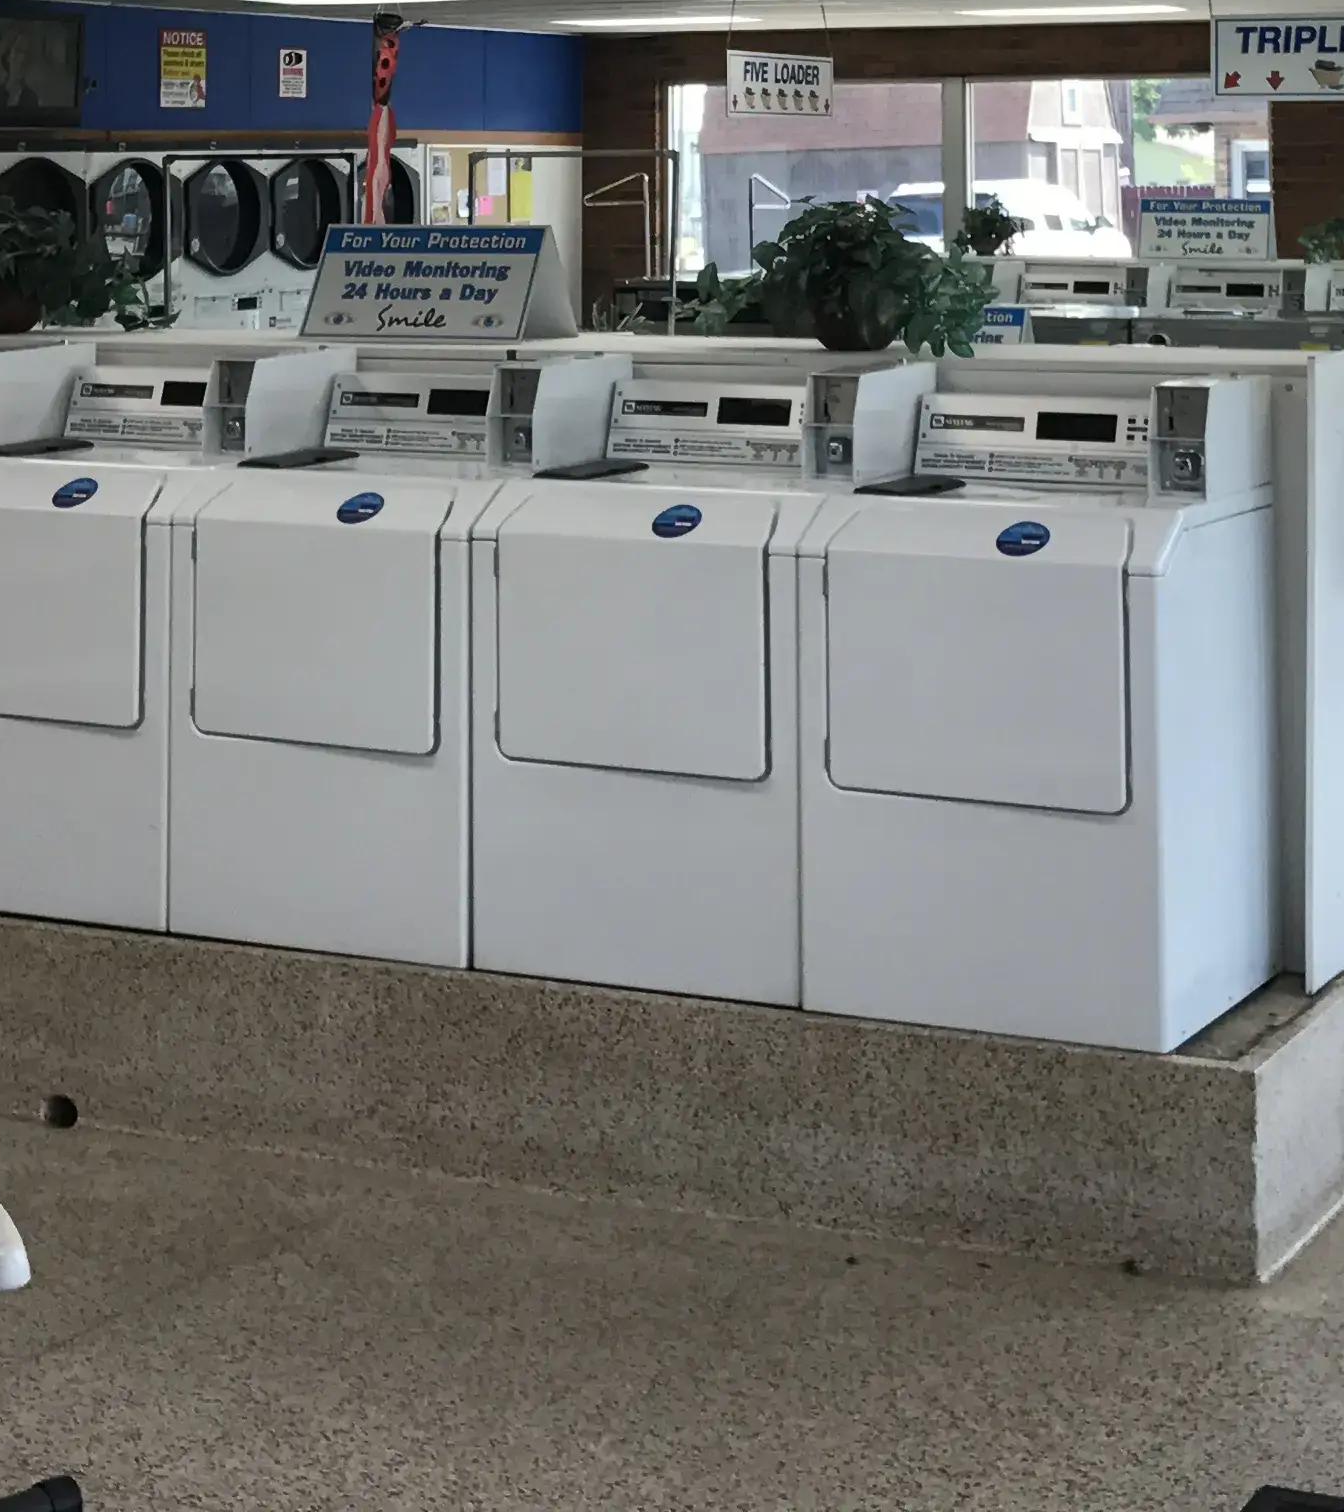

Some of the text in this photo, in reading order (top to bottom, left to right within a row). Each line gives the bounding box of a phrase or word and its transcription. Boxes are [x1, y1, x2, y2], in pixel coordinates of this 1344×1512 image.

[162, 31, 204, 46] NOTICE
[743, 60, 820, 86] FIVE LOADER
[1149, 201, 1262, 212] For Your Protection
[1154, 216, 1256, 229] Video Monitoring
[341, 232, 526, 250] For Your Protection
[1157, 229, 1251, 241] 24 Hours a Day
[1181, 241, 1225, 256] Smile
[344, 260, 511, 281] Video Monitoring
[341, 283, 499, 304] 24 Hours a Day
[376, 304, 447, 332] Smile
